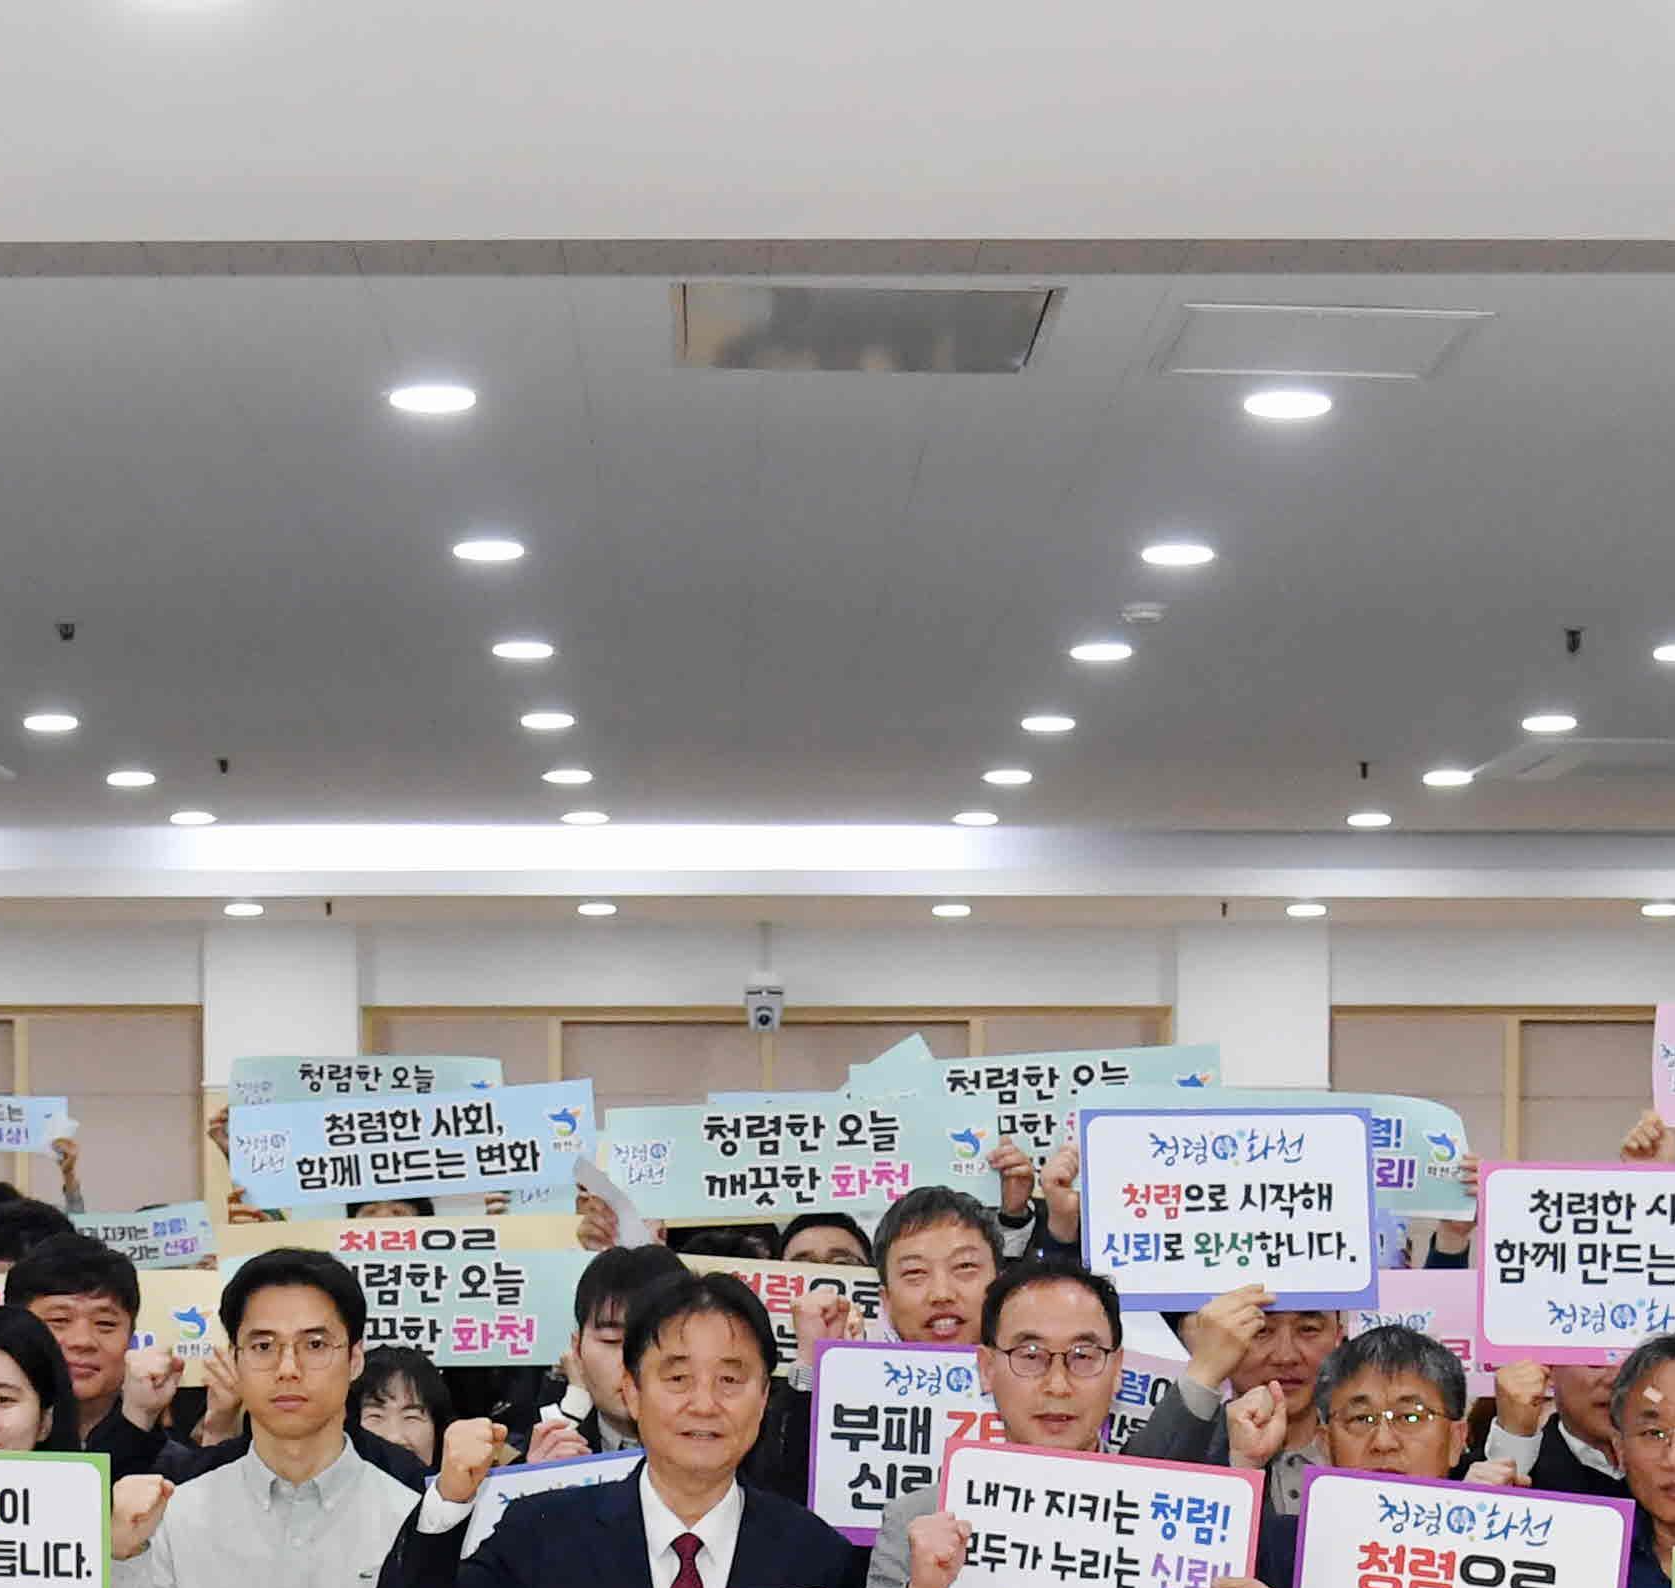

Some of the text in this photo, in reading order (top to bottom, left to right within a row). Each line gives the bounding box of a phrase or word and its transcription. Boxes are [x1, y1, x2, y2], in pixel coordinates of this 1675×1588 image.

[299, 1063, 382, 1093] 청렴한
[391, 1065, 436, 1093] 오늘
[324, 1103, 503, 1147] 청렴한 사회,
[703, 1111, 900, 1156] 청렴한 오늘
[297, 1140, 540, 1190] 함께 만드는 변화
[705, 1163, 914, 1206] 깨끗한 화천
[1123, 1183, 1333, 1218] 청렴으로 시작해
[1529, 1189, 1636, 1235] 청렴한
[1102, 1232, 1357, 1267] 신뢰로 완성합니다.
[1495, 1240, 1566, 1285] 함께
[355, 1263, 524, 1305] 렴한 오늘
[452, 1316, 536, 1356] 화천
[831, 1404, 932, 1454] 부패
[966, 1480, 1231, 1544] 내가 지키는 청렴!
[963, 1532, 1042, 1573] 모두가
